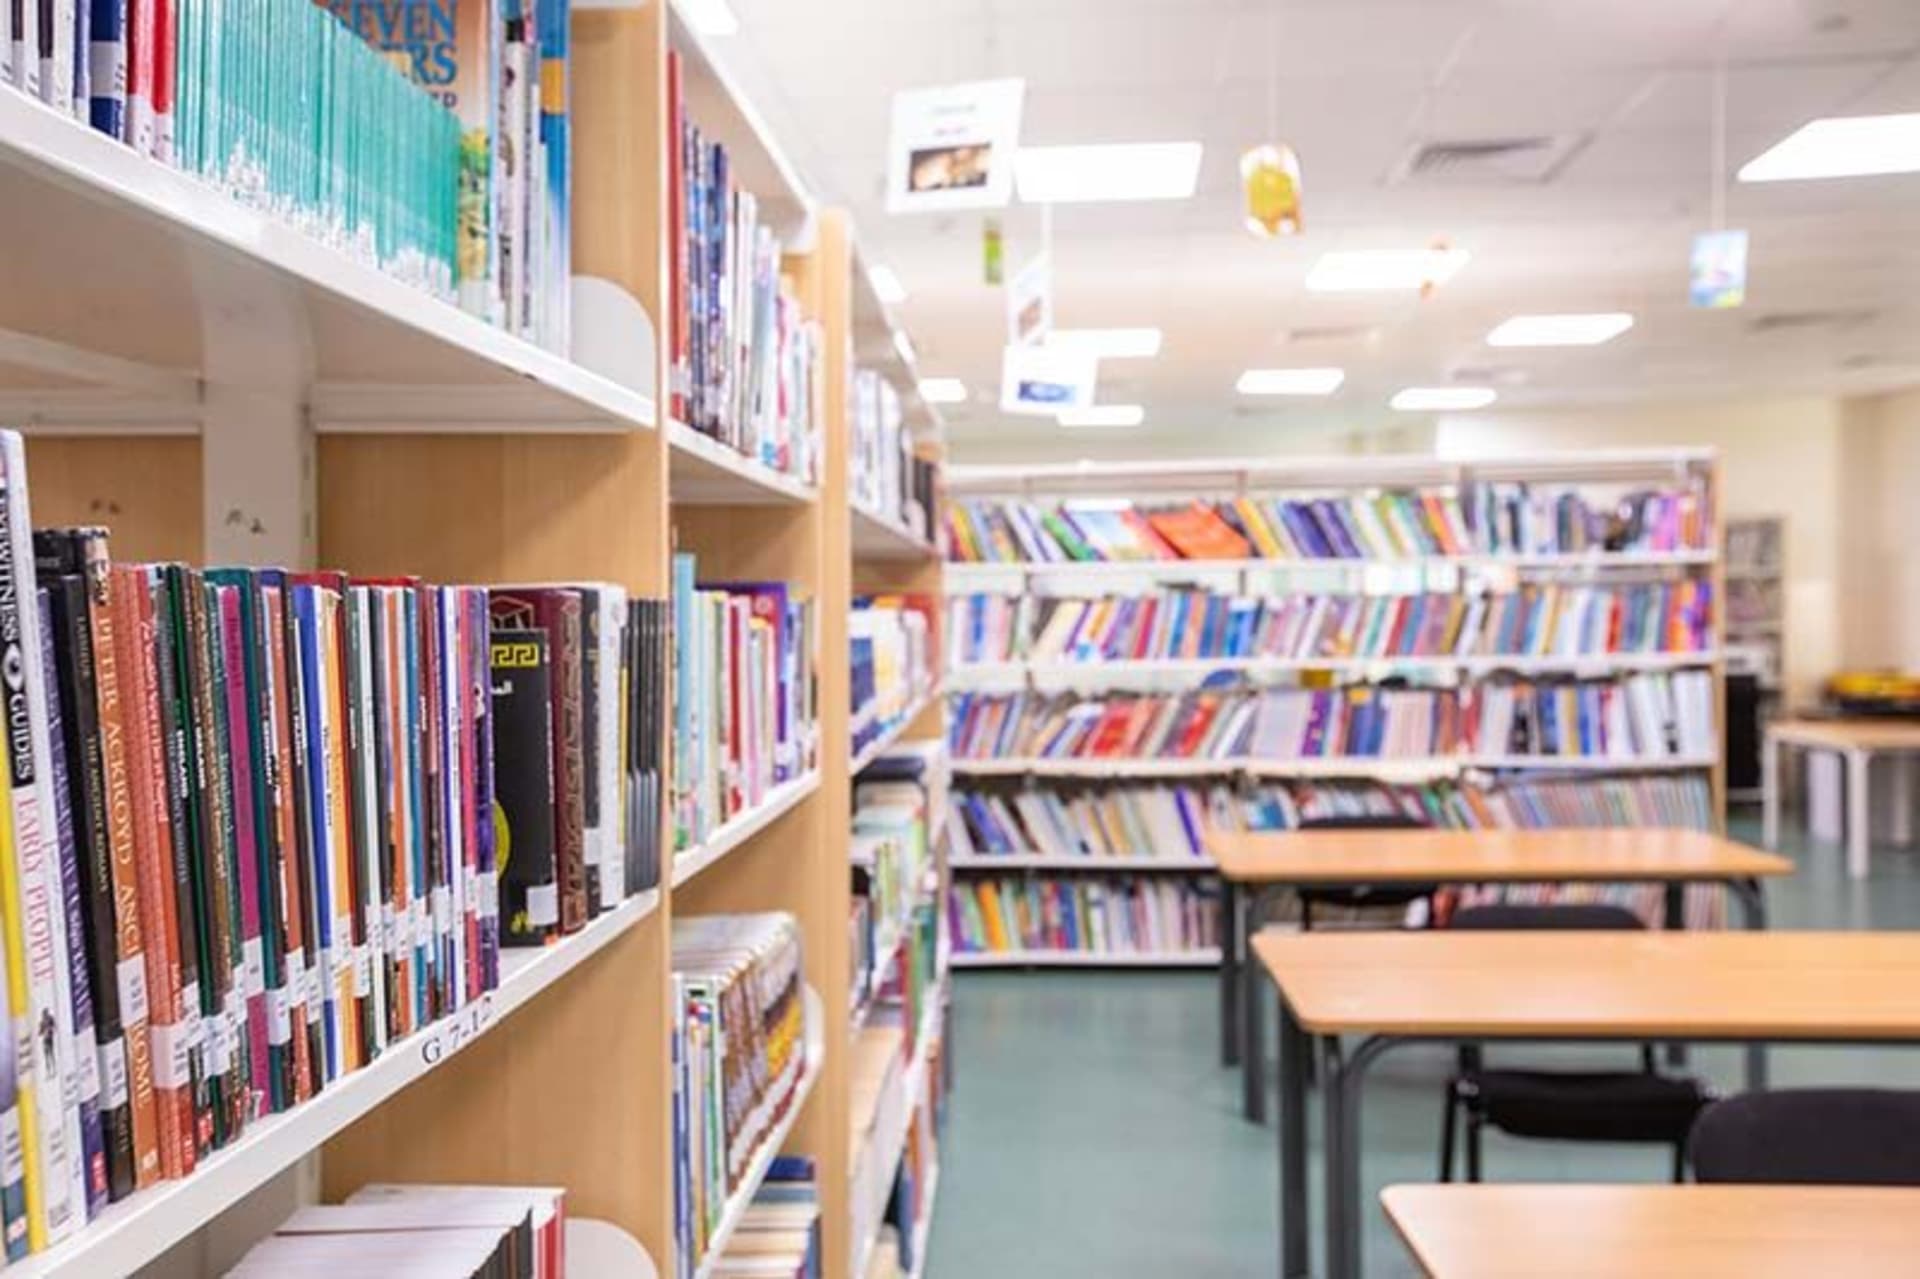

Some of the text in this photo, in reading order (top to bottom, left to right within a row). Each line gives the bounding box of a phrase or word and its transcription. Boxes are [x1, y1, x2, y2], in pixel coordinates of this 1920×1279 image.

[9, 692, 35, 779] GUIDES
[96, 616, 134, 866] PETER ACKROYD
[16, 796, 57, 986] EARLY PEOPLE
[119, 883, 142, 956] ANCI
[130, 1018, 153, 1108] ROME
[421, 995, 493, 1065] G 7-12
